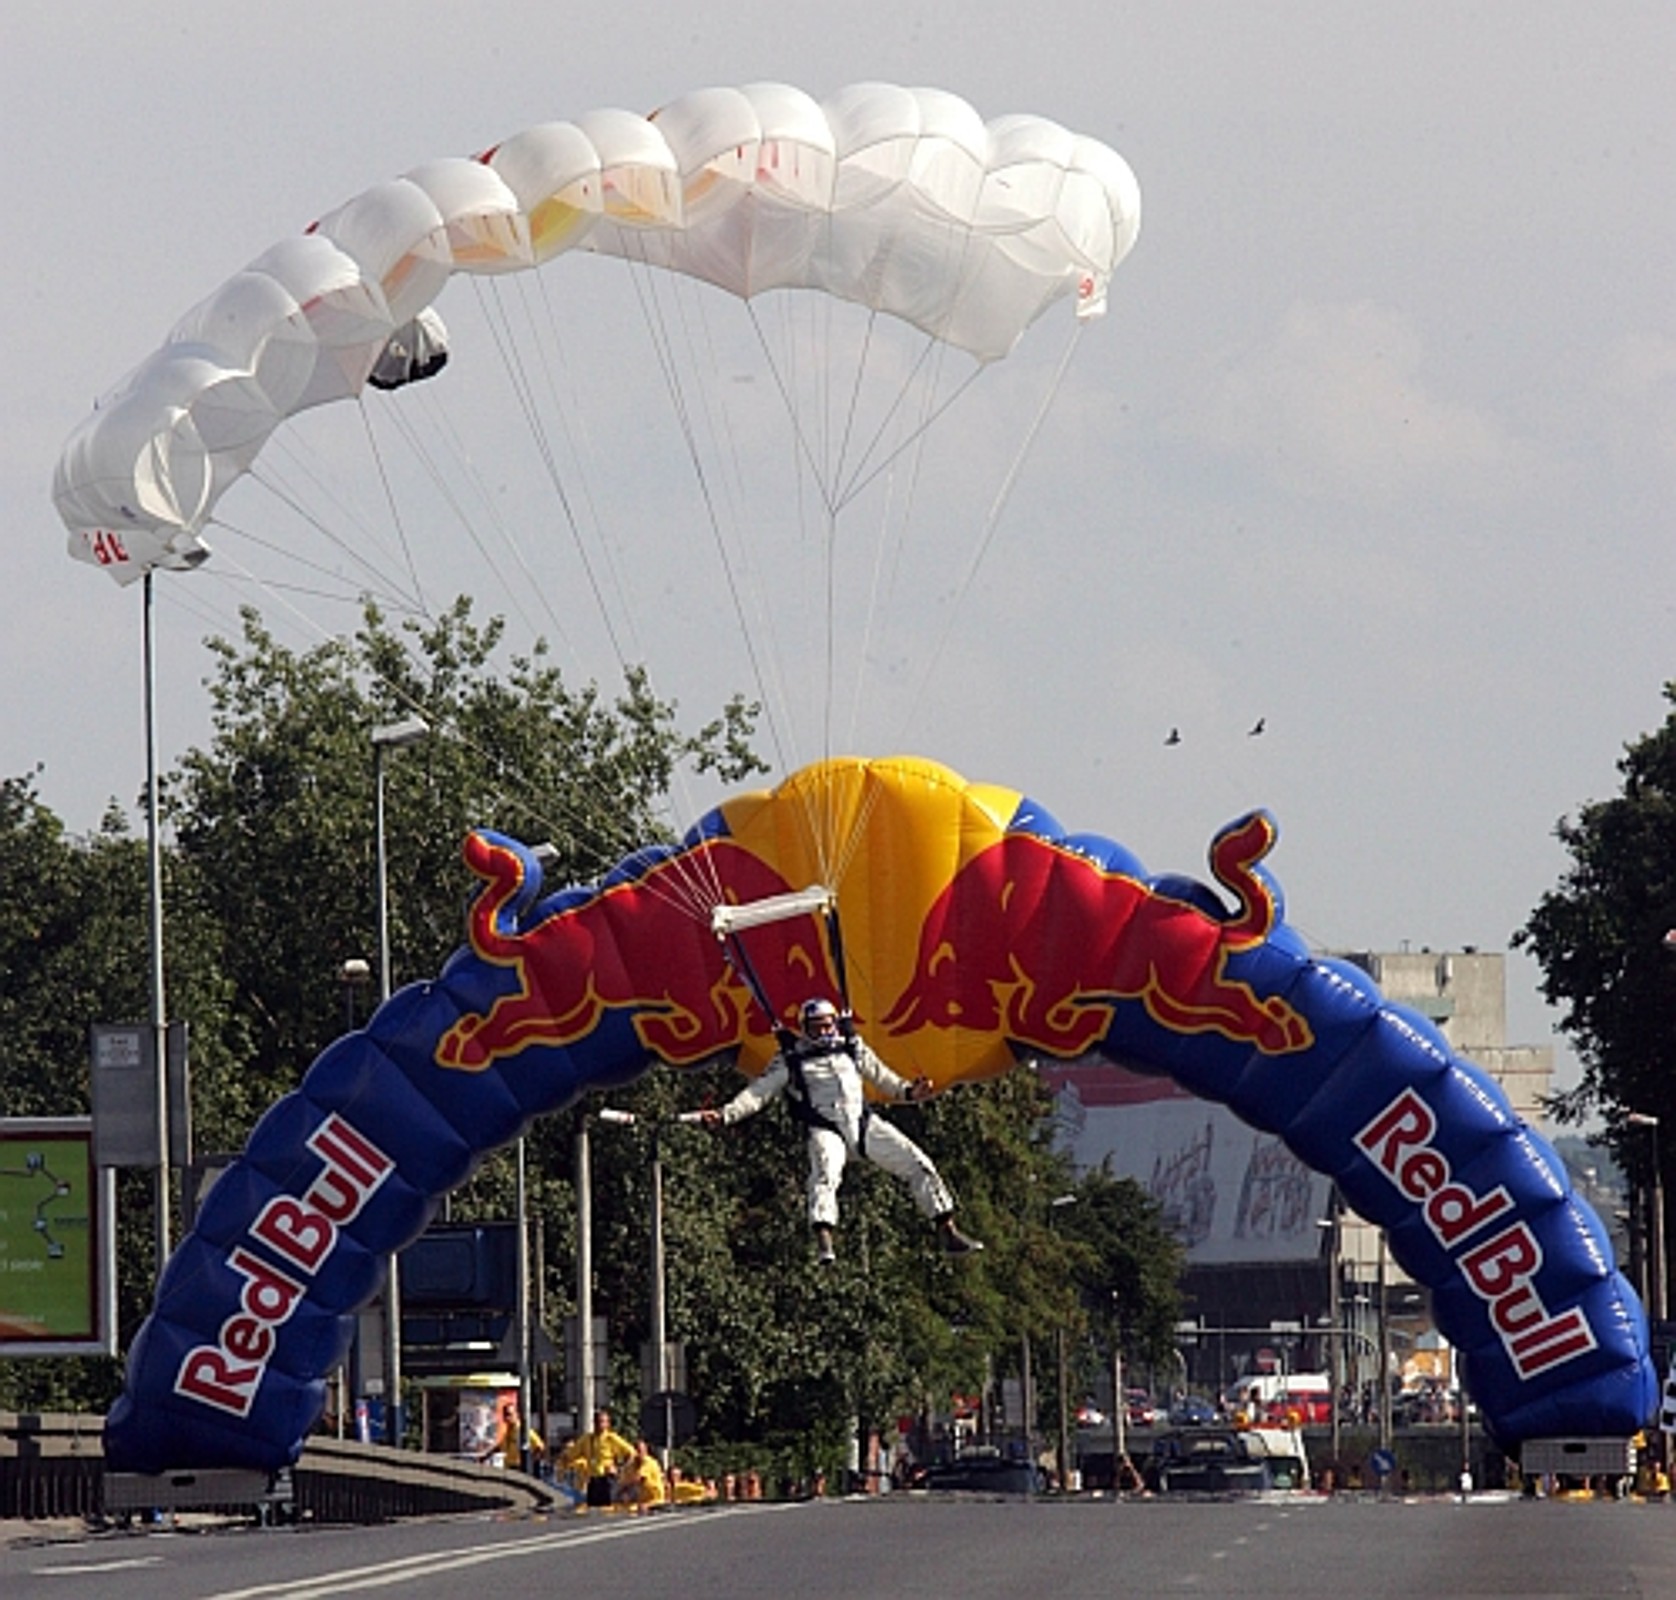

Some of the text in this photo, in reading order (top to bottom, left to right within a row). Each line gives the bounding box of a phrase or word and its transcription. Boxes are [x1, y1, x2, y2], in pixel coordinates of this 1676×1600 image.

[175, 1112, 395, 1417] Red Bull
[1354, 1089, 1597, 1380] Red Bull
